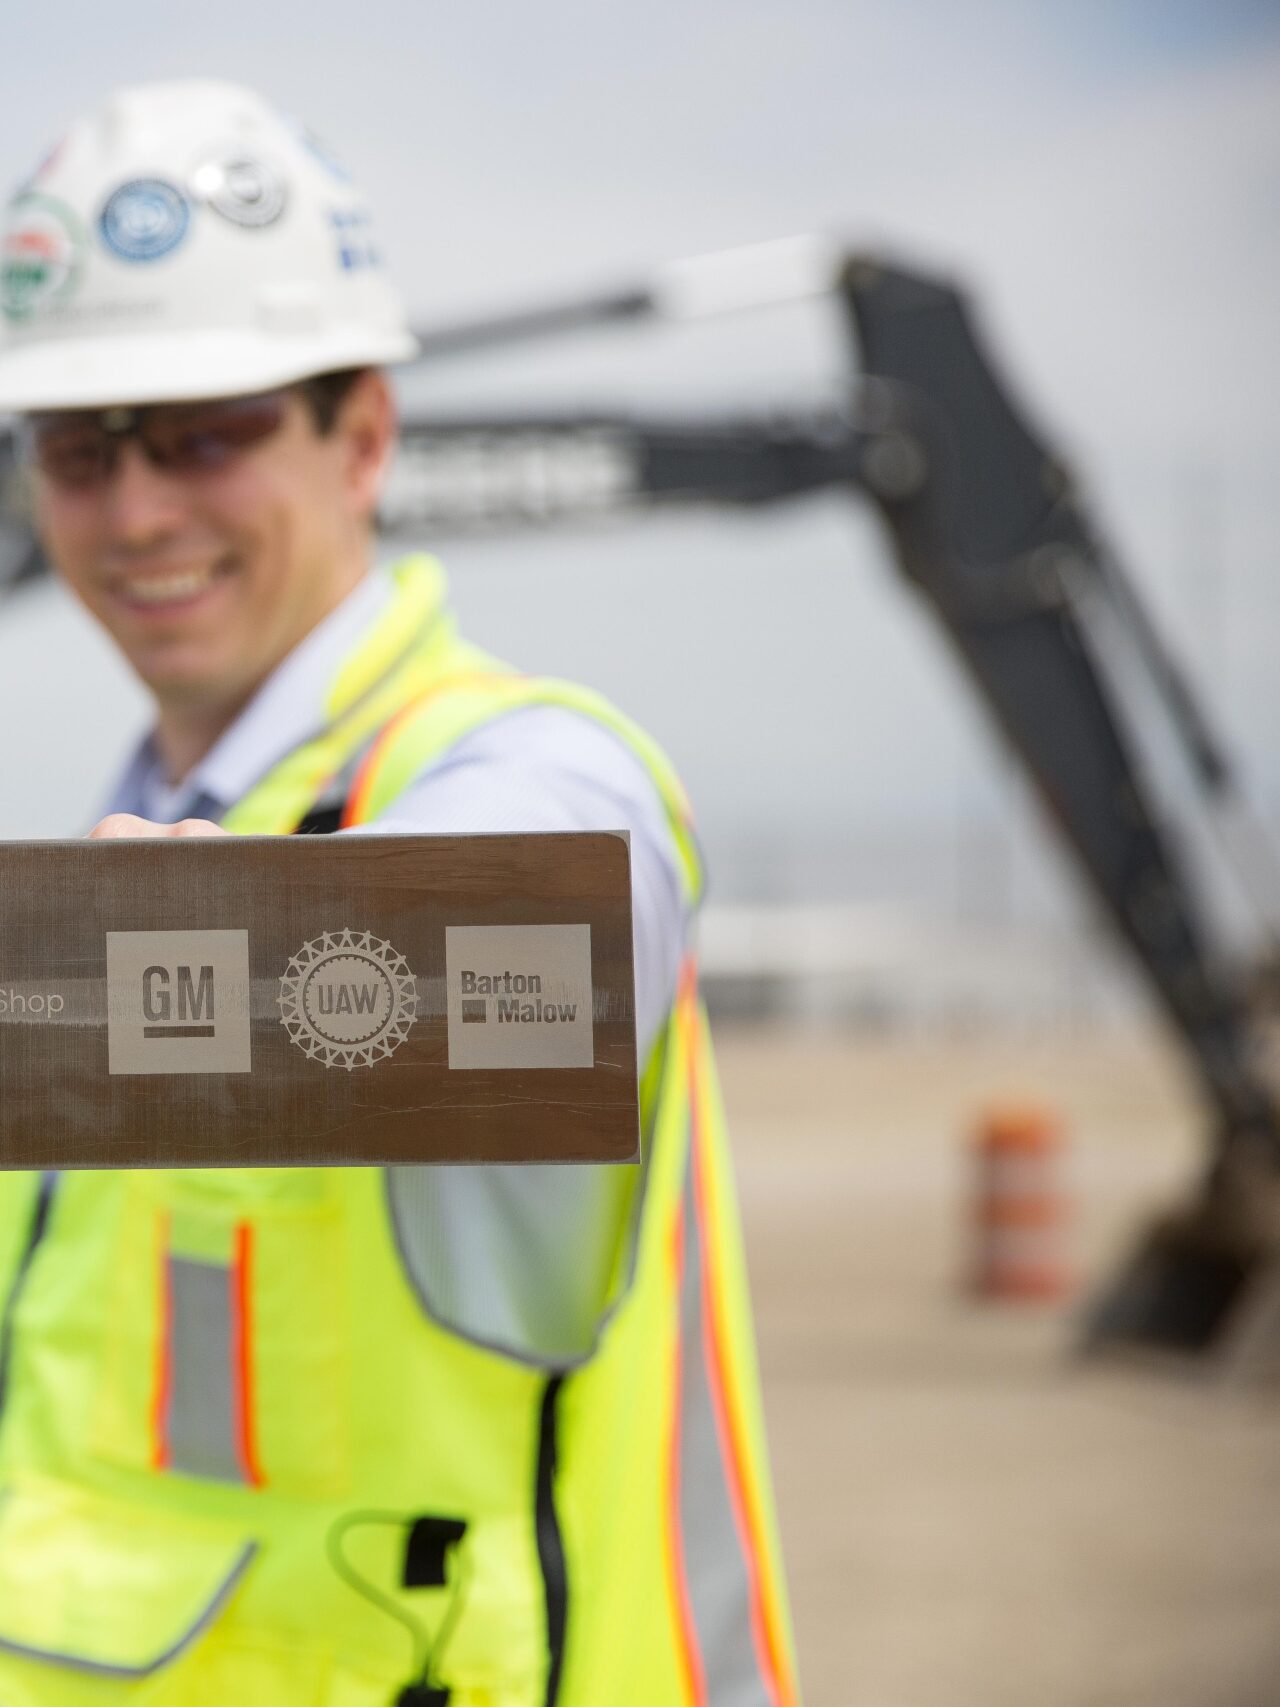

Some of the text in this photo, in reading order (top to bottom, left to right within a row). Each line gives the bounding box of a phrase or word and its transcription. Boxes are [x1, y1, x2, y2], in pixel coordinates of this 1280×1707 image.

[142, 965, 215, 1022] GM
[460, 970, 542, 995] Barton
[319, 984, 379, 1016] UAW
[497, 998, 577, 1024] Malow
